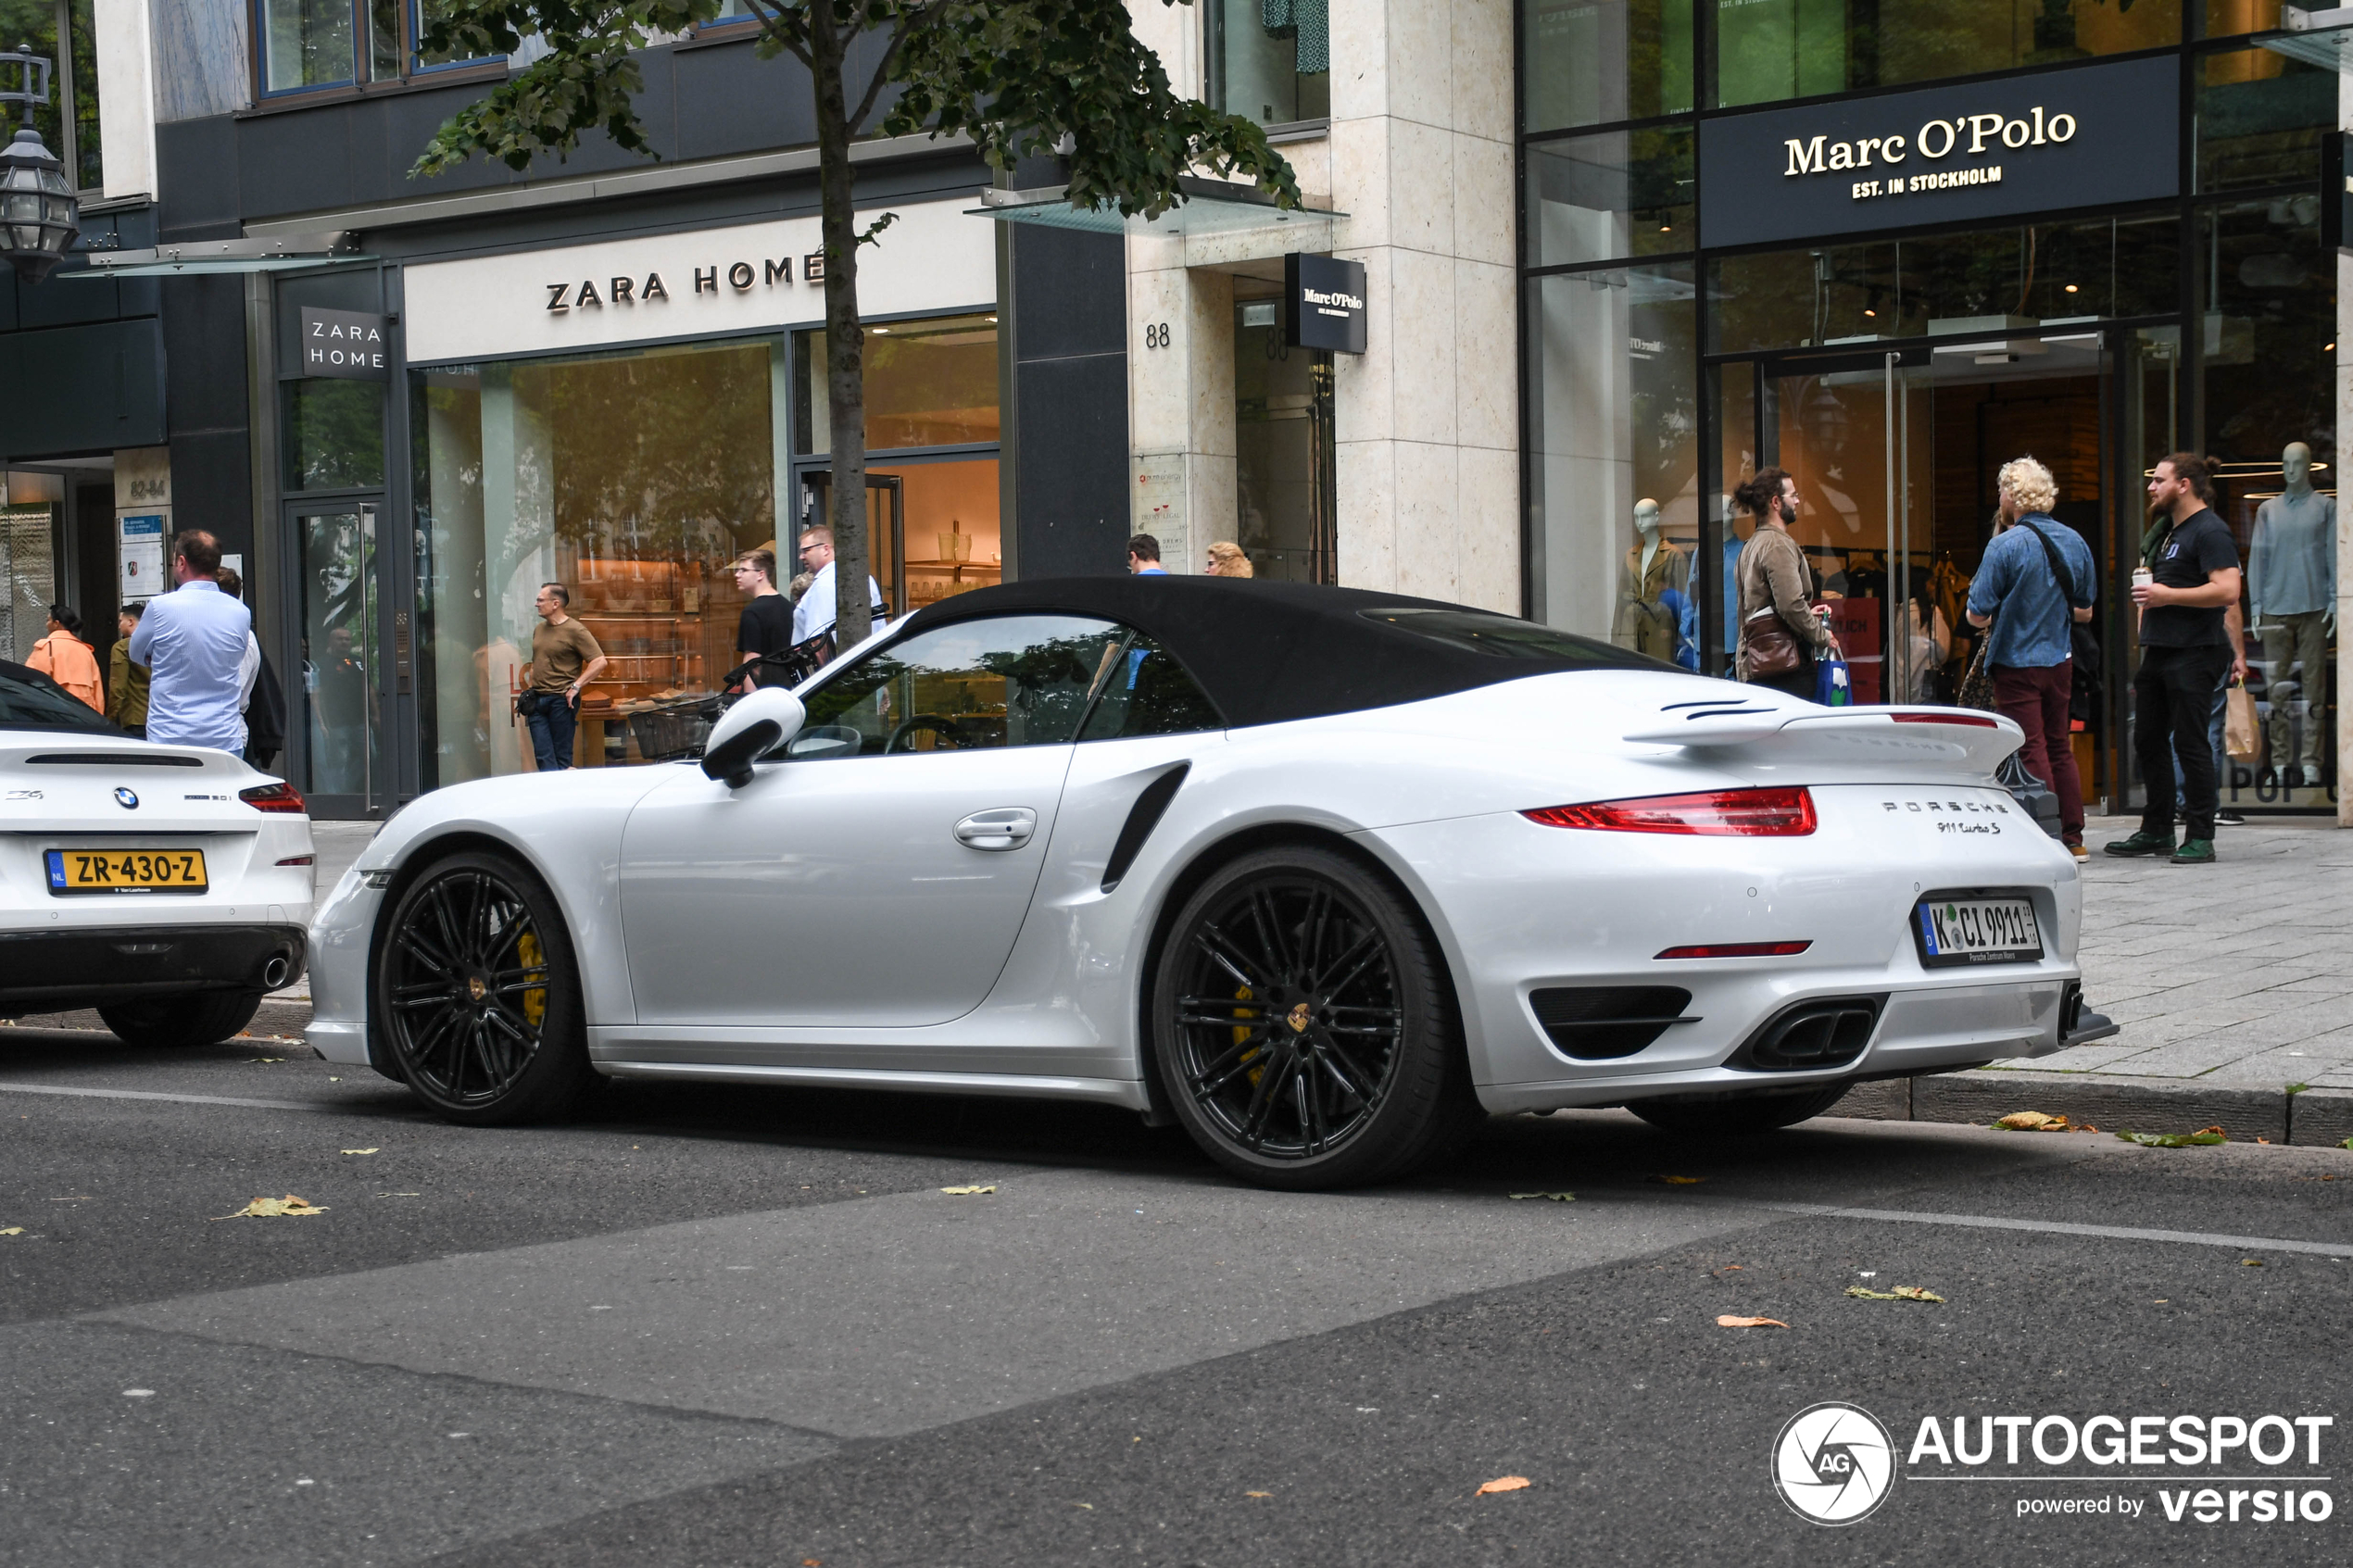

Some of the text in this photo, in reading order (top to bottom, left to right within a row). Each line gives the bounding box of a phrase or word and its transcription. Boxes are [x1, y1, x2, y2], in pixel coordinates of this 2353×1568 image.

[1783, 106, 2077, 176] Marc O'Polo
[1852, 165, 2002, 199] EST. IN STOCKHOLM
[547, 254, 825, 310] ZARA HOME
[1303, 288, 1363, 309] Marc O'Polo
[312, 321, 381, 343] ZARA
[1146, 322, 1170, 349] 88
[310, 348, 384, 369] HOME
[131, 480, 165, 498] 82-84
[5, 790, 44, 800] Z4
[1881, 801, 2008, 814] PORSCHE
[1936, 822, 1957, 834] 911
[1991, 822, 2001, 834] S
[52, 872, 65, 882] NL
[75, 855, 197, 883] ZR-430-Z
[1932, 908, 1951, 949] K
[1926, 935, 1933, 947] D
[1969, 952, 1987, 962] Porsche
[1986, 951, 2004, 961] Zentrum
